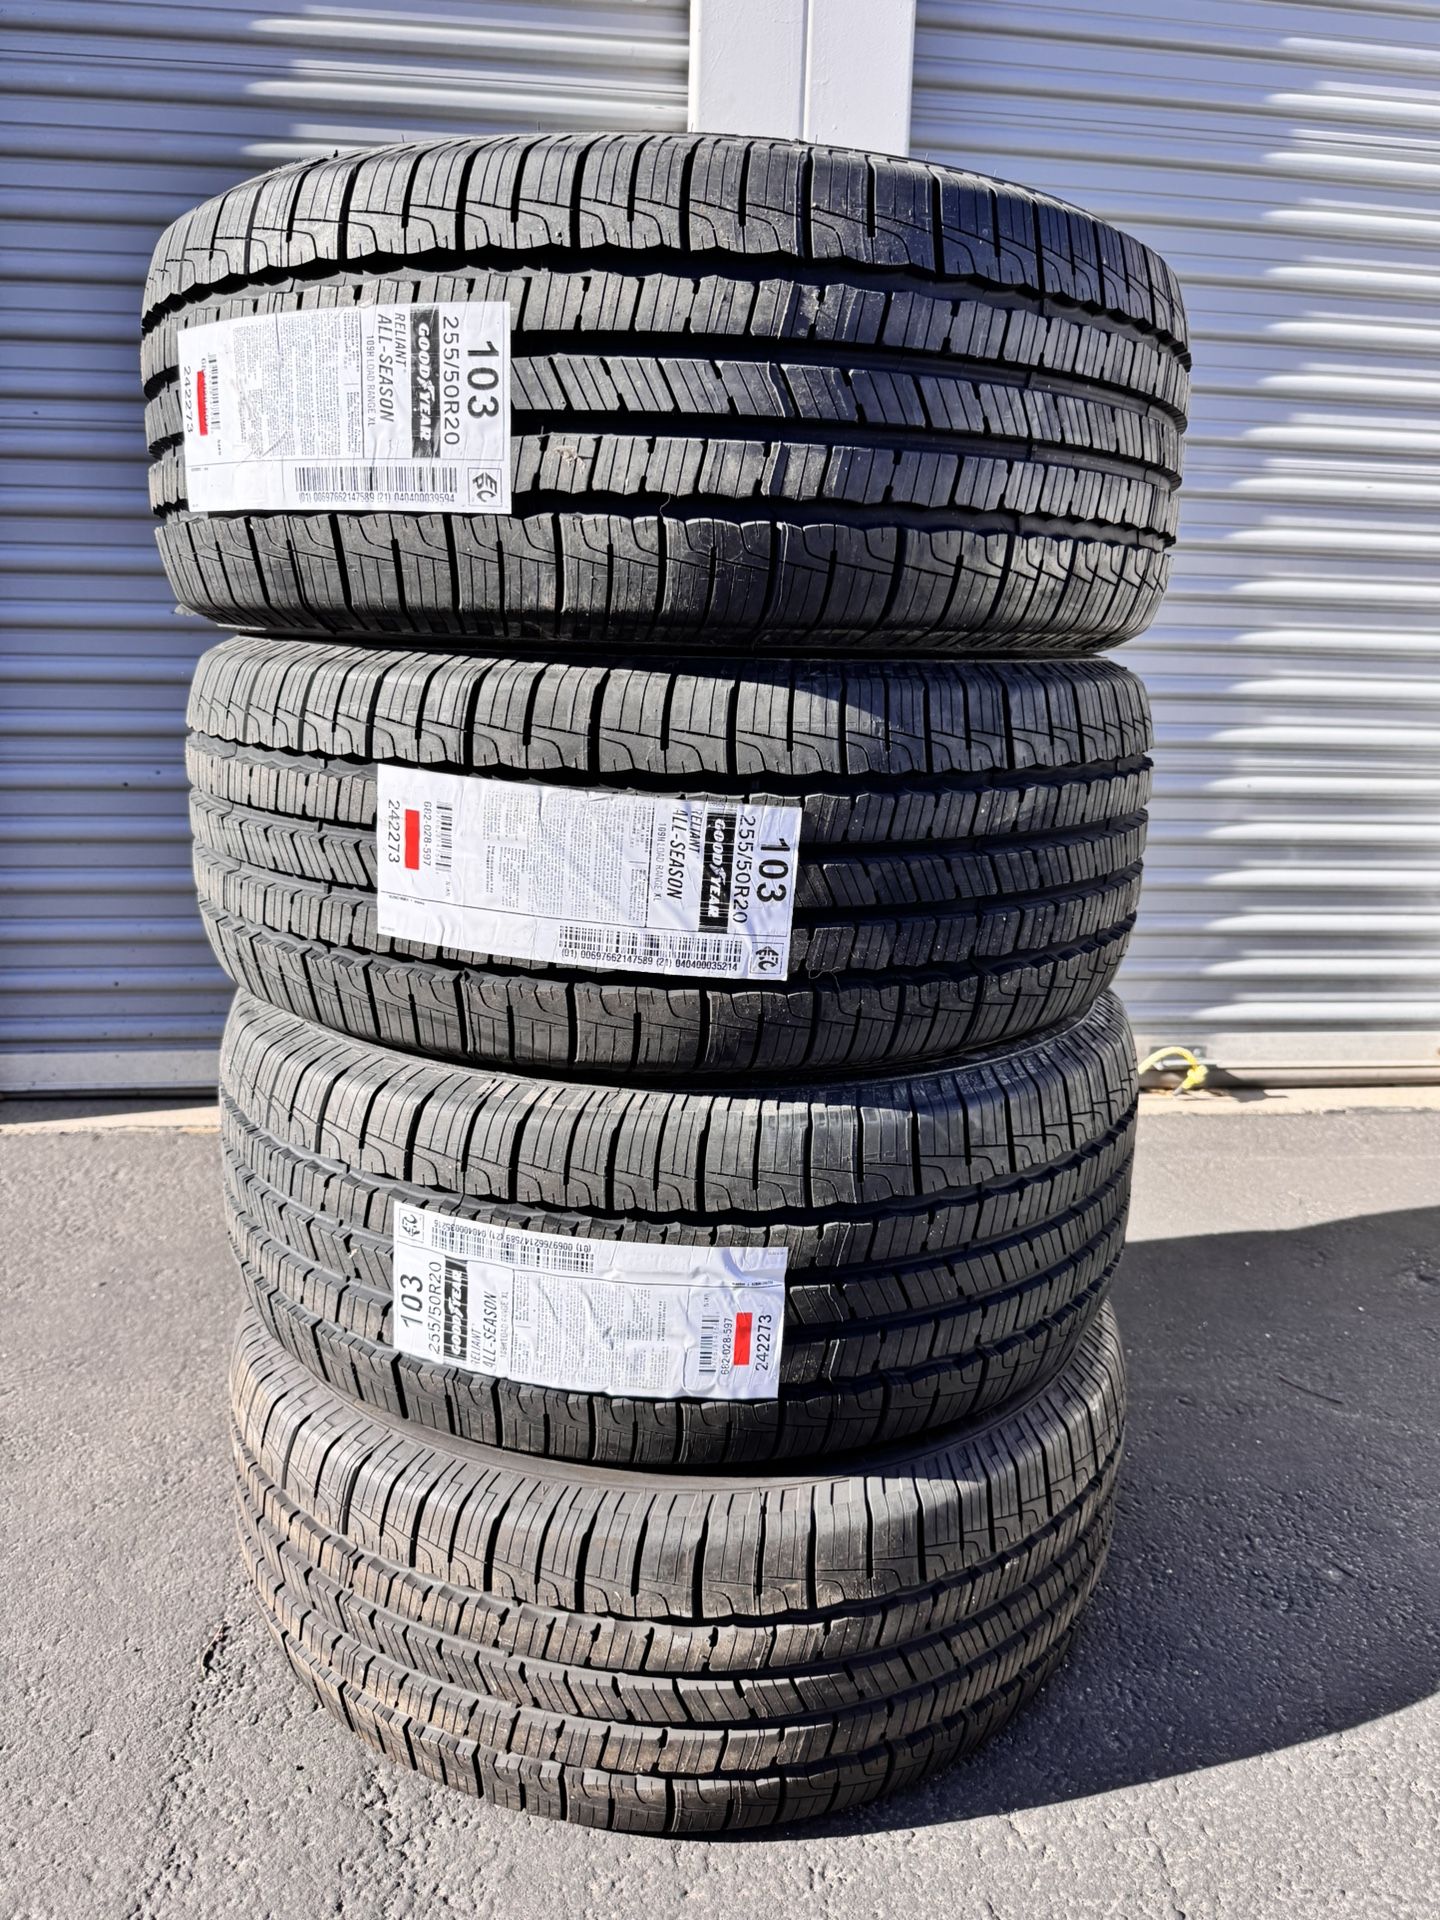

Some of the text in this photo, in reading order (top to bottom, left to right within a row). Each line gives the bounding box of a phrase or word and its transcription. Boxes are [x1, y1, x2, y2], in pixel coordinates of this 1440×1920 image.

[367, 359, 375, 381] LOAD
[378, 314, 394, 422] ALL-SEASON
[395, 313, 406, 367] RELIANT
[184, 366, 193, 433] 242273
[367, 385, 376, 414] RANGE
[443, 316, 459, 445] 255/50R20
[467, 341, 499, 419] 103
[368, 417, 376, 427] XL
[388, 800, 400, 863] 242273
[423, 801, 432, 866] 682-028-597
[653, 823, 667, 902] 109H LOAD RANGE XL
[732, 815, 755, 924] 255/50R20
[757, 838, 790, 903] 103
[561, 948, 738, 972] (01) 00697662147589 (21) 040400035214
[576, 1244, 591, 1252] (01)
[400, 1274, 423, 1328] 103
[428, 1261, 441, 1354] 255/50R20
[720, 1318, 732, 1375] 682-028-597
[755, 1314, 772, 1371] 242273
